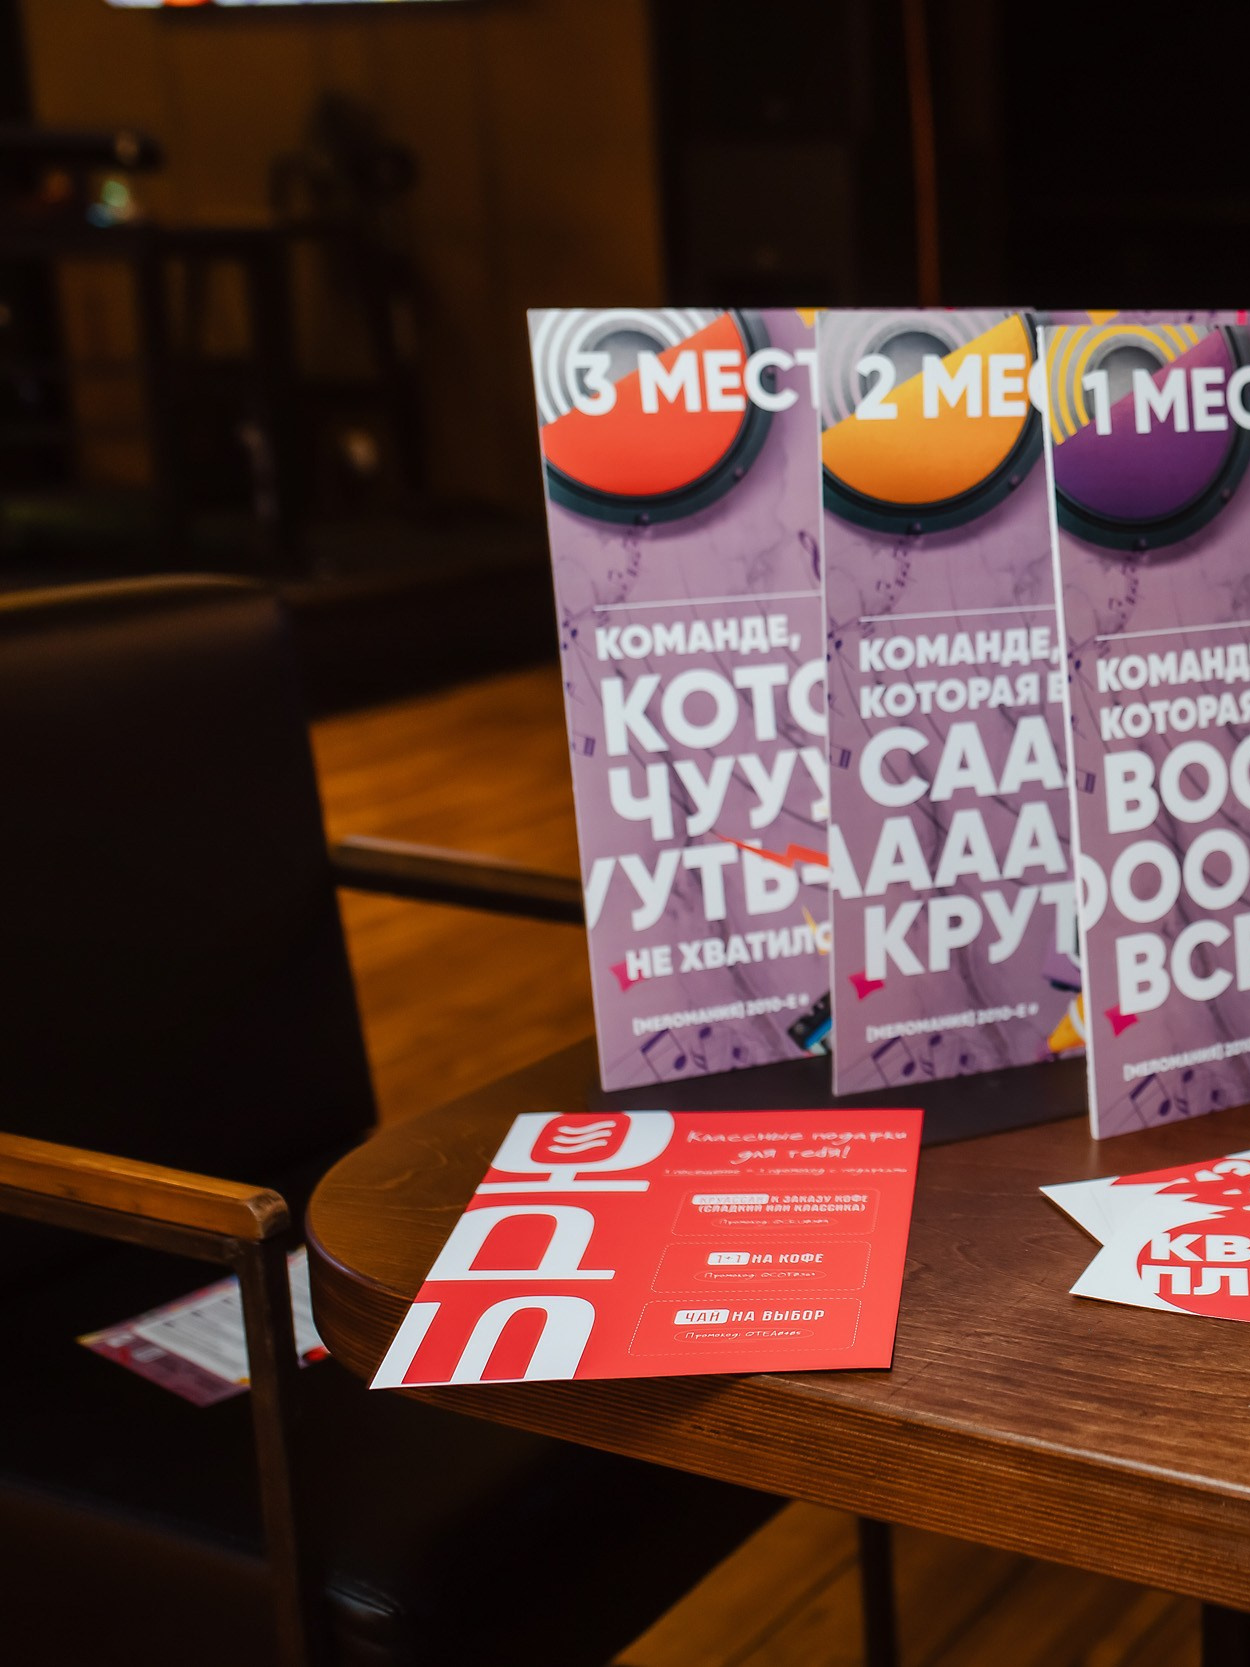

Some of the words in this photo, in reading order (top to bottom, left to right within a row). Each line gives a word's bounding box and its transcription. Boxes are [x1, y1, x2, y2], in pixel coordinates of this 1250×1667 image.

[570, 351, 617, 416] 3
[856, 355, 898, 421] 2
[1082, 369, 1113, 435] 1
[595, 614, 801, 661] КОМАНДЕ,
[860, 626, 1060, 673] КОМАНДЕ,
[860, 672, 1040, 720] КОТОРАЯ
[858, 715, 1066, 808] САА
[626, 946, 672, 981] НЕ
[687, 1130, 804, 1143] Классные
[811, 1131, 907, 1146] подарки
[730, 1148, 777, 1165] для
[782, 1195, 832, 1203] ЗАКАЗУ
[834, 1194, 869, 1203] КОФЕ
[751, 1254, 773, 1264] НА
[778, 1253, 824, 1264] КОФЕ
[685, 1311, 721, 1323] ЧАЙ
[731, 1310, 755, 1322] НА
[762, 1309, 826, 1321] ВЫБОР
